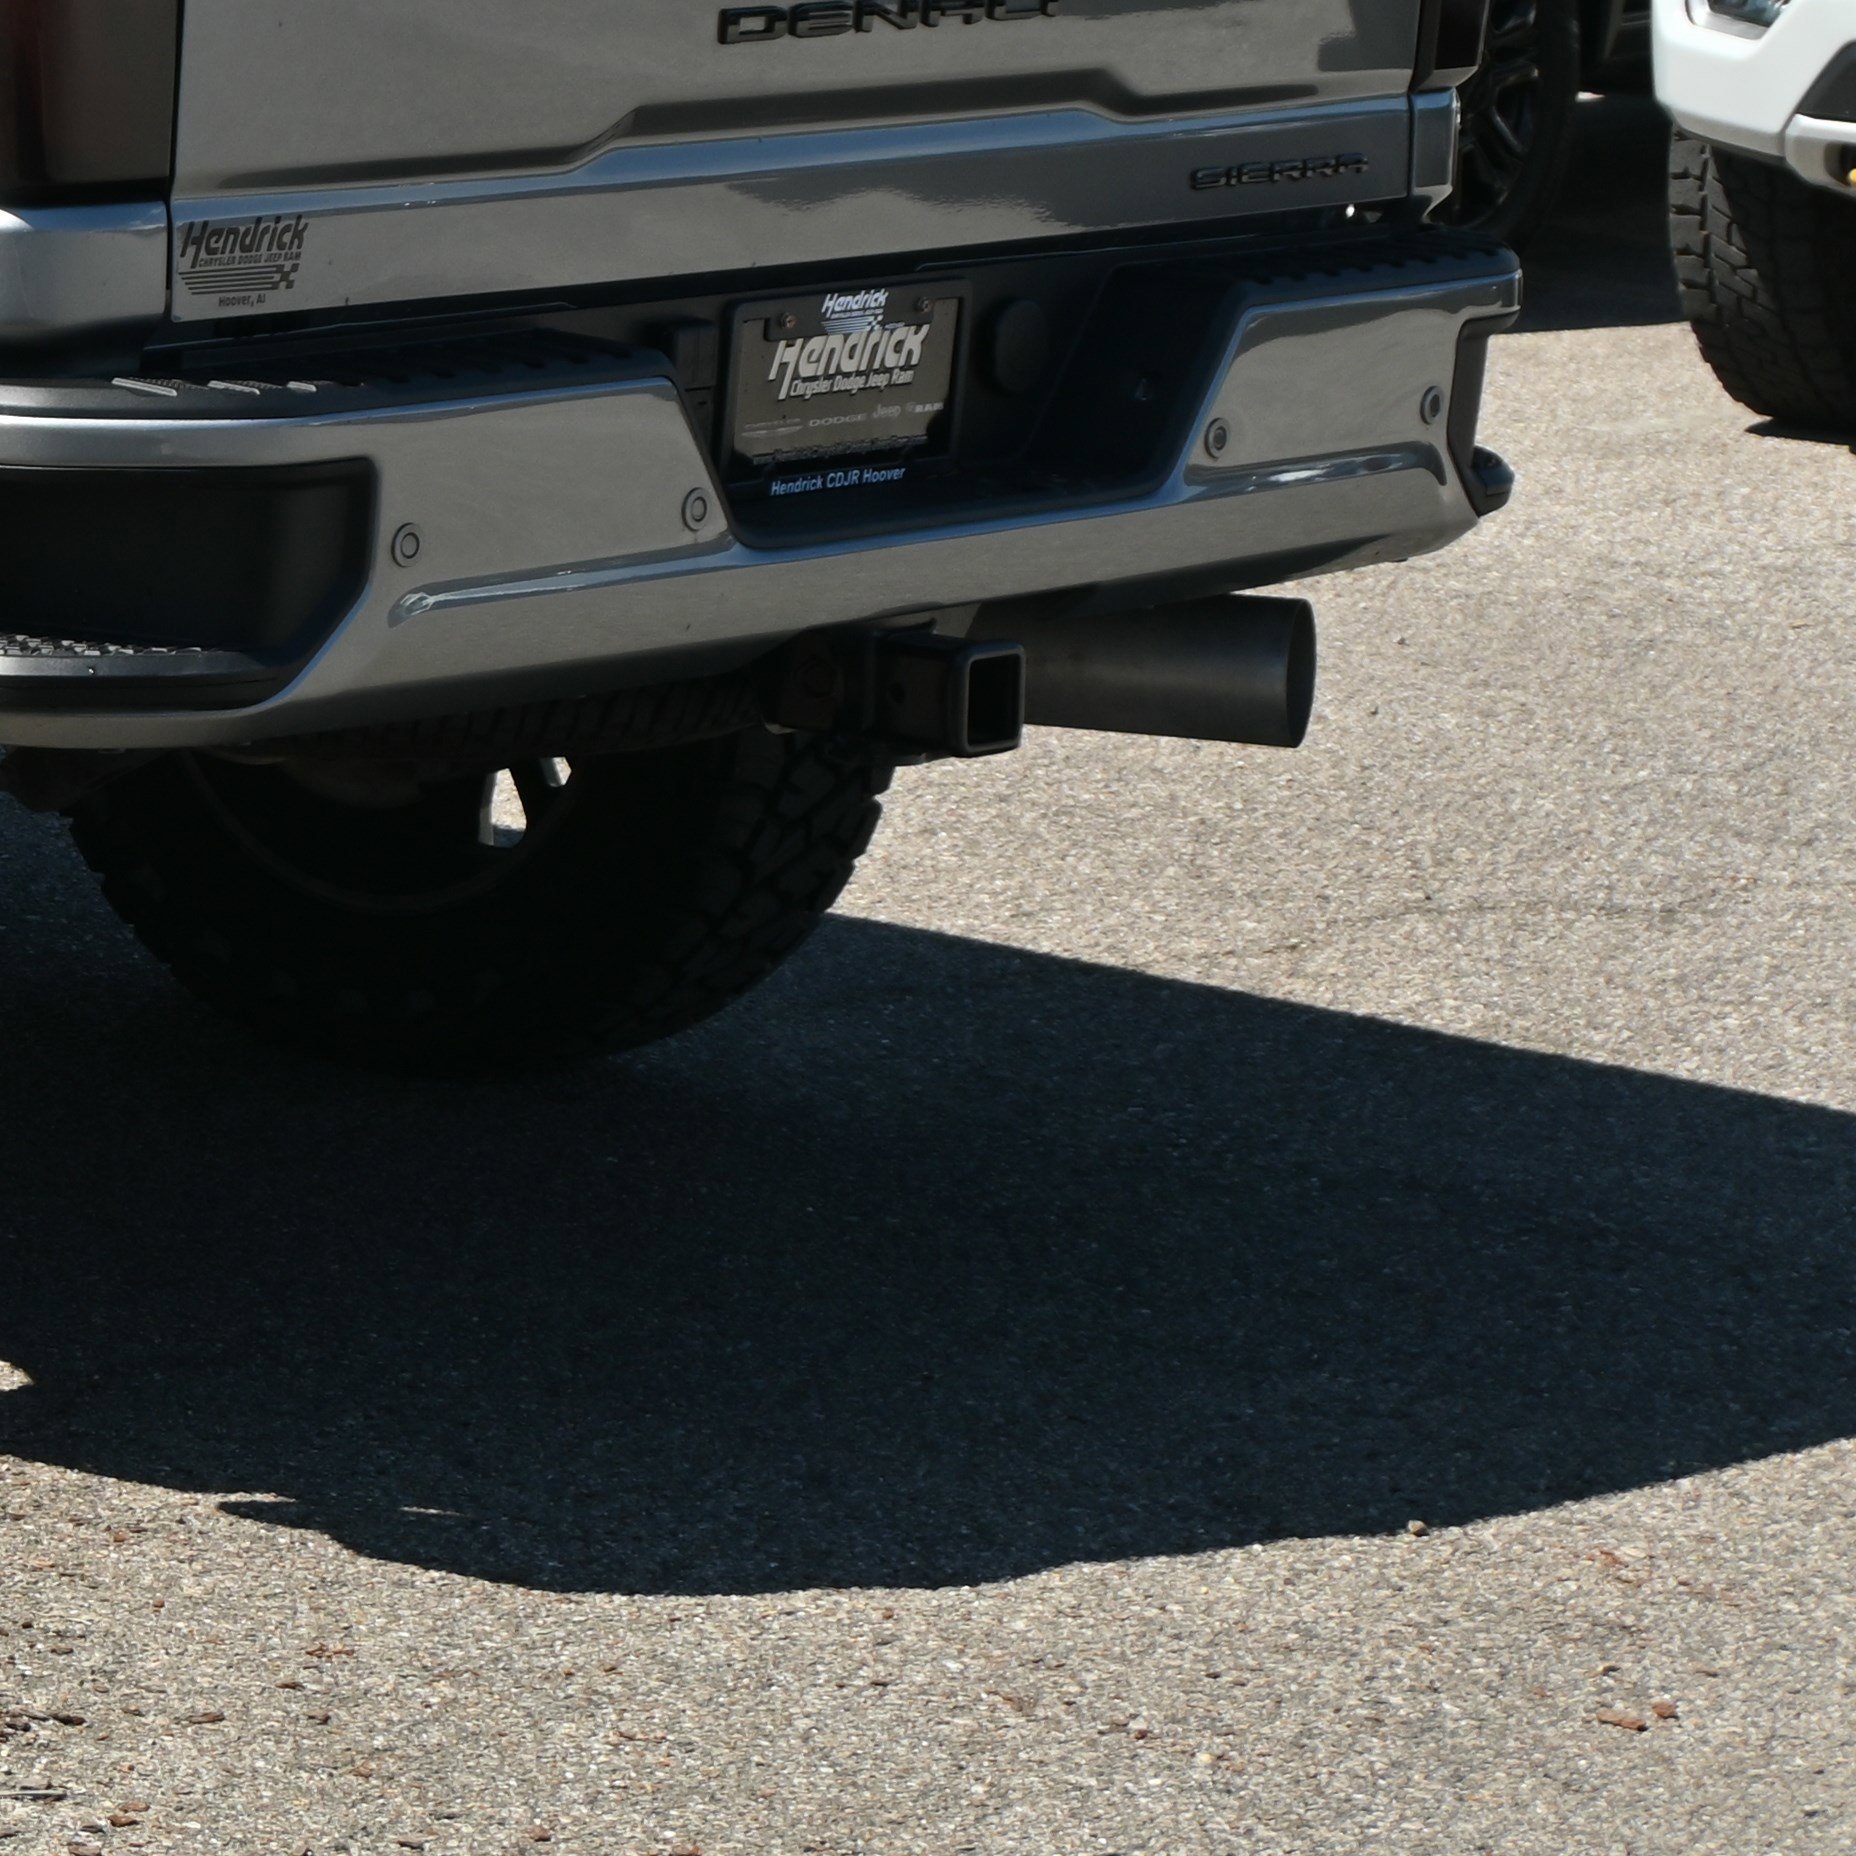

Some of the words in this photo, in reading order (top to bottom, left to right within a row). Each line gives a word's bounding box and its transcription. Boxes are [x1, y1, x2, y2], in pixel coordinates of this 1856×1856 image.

[1191, 152, 1368, 190] SIERRA
[180, 214, 309, 269] Hendrick
[199, 256, 236, 267] CHRYSLER
[239, 254, 262, 265] DODGE
[264, 252, 282, 263] JEEP
[284, 251, 301, 262] RAM
[821, 288, 889, 318] Hendrick
[767, 324, 930, 401] Hendrick
[790, 377, 833, 399] Chrysler
[833, 373, 866, 395] Dodge
[866, 371, 889, 391] Jeep
[890, 368, 914, 384] Ram
[809, 412, 869, 427] DODGE
[872, 403, 901, 419] Jeep
[770, 475, 823, 496] Hendrick
[826, 469, 859, 489] CDJR
[862, 467, 906, 485] Hoover
